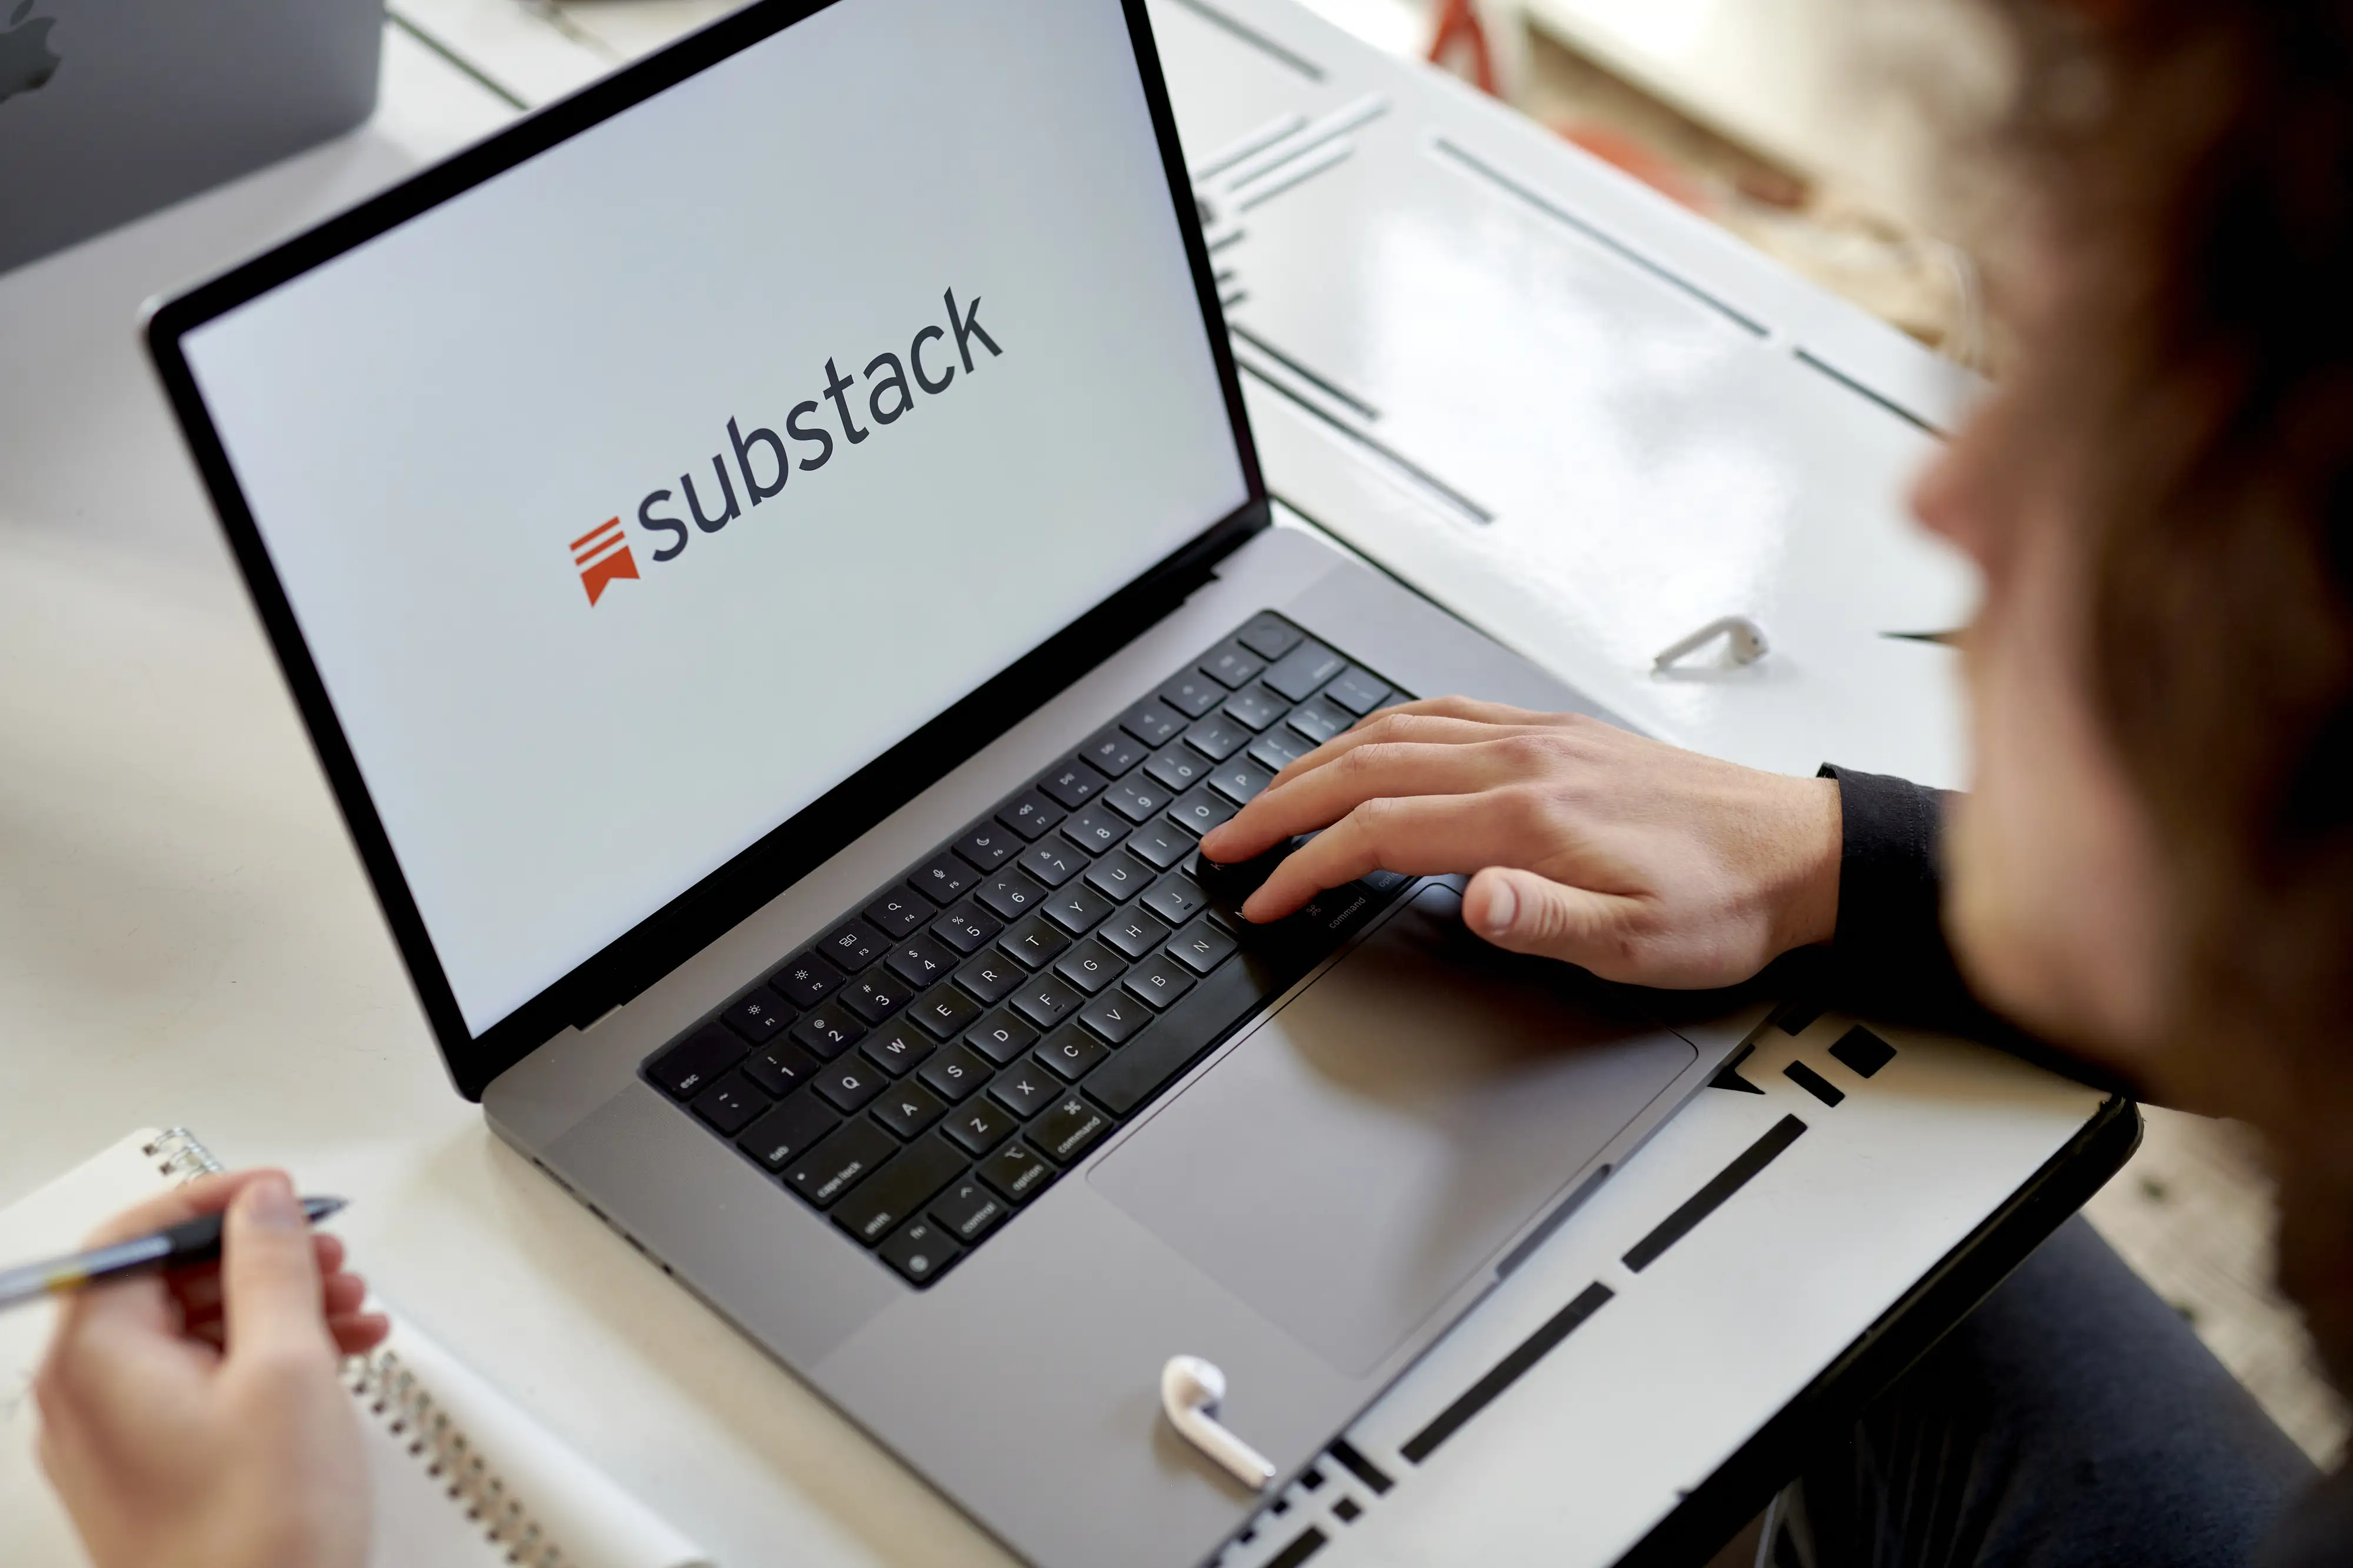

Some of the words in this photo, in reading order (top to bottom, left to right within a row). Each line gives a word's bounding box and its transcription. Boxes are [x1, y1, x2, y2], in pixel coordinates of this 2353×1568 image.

[637, 286, 1004, 562] substack
[1178, 766, 1192, 776] 0
[1235, 775, 1247, 786] P
[1138, 796, 1152, 808] 9
[1195, 806, 1209, 817] O
[1096, 828, 1111, 839] 8
[1156, 839, 1167, 848] I
[1053, 860, 1065, 870] 7
[1210, 860, 1225, 871] K
[1111, 869, 1127, 880] U
[949, 880, 959, 889] F5
[1011, 892, 1025, 903] 6
[1172, 893, 1182, 903] J
[1069, 901, 1083, 912] Y
[905, 914, 915, 922] F4
[1328, 896, 1366, 929] command
[952, 916, 964, 925] %
[966, 926, 980, 936] 5
[1125, 925, 1142, 938] H
[1025, 935, 1039, 946] T
[858, 948, 869, 956] F3
[1193, 940, 1209, 953] N
[924, 960, 936, 970] 4
[1084, 960, 1098, 970] G
[982, 970, 998, 982] R
[1151, 975, 1166, 987] B
[812, 982, 823, 990] F2
[863, 984, 871, 993] #
[875, 995, 889, 1006] 3
[1039, 993, 1051, 1006] F
[936, 1004, 952, 1016] E
[1106, 1009, 1121, 1020] V
[765, 1017, 775, 1026] F1
[814, 1019, 825, 1029] @
[828, 1030, 844, 1042] 2
[993, 1030, 1009, 1042] D
[886, 1038, 906, 1053] W
[1064, 1045, 1079, 1057] C
[781, 1067, 794, 1076] 1
[947, 1065, 963, 1077] S
[680, 1074, 699, 1089] esc
[842, 1076, 860, 1089] Q
[1016, 1080, 1035, 1095] X
[902, 1103, 918, 1116] A
[970, 1117, 988, 1133] Z
[1057, 1115, 1101, 1154] command
[769, 1146, 789, 1161] tab
[816, 1175, 842, 1198] caps
[839, 1160, 862, 1181] lock
[1012, 1164, 1044, 1191] option
[961, 1201, 997, 1233] control
[865, 1212, 890, 1235] shift
